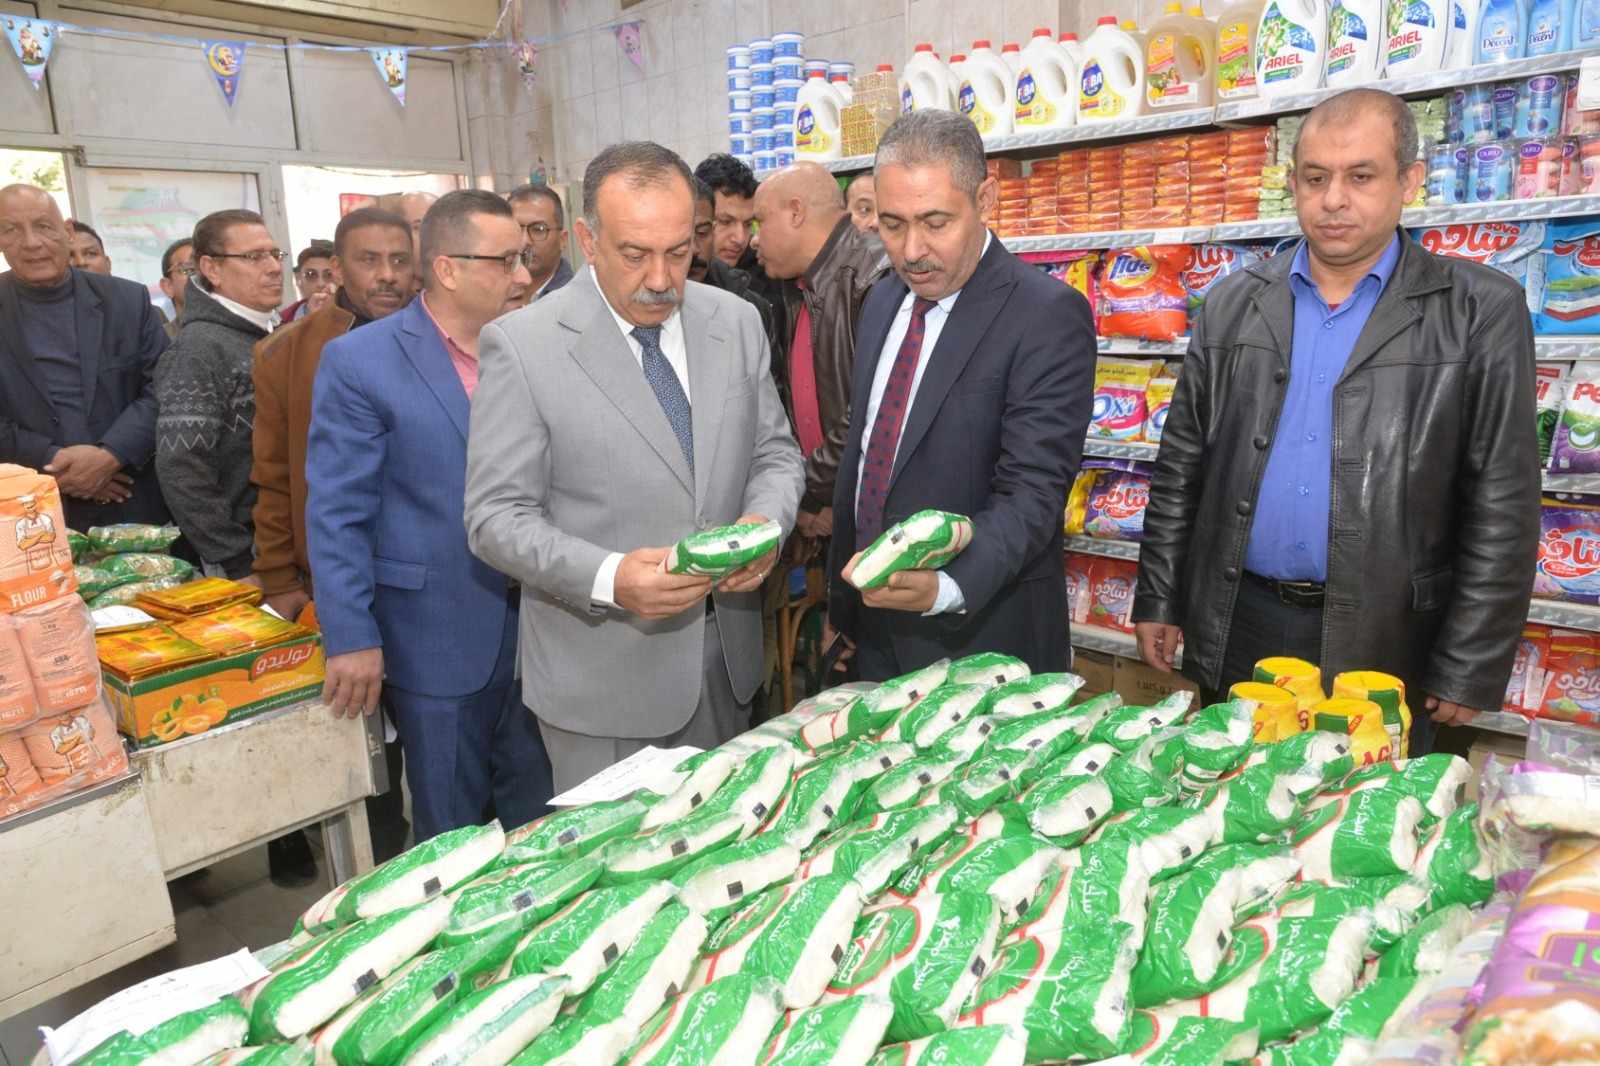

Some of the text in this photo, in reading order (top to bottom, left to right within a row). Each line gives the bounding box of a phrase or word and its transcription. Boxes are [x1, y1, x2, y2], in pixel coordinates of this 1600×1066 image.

[1388, 30, 1422, 50] ARIEL
[1329, 42, 1356, 60] ARIEL
[1264, 52, 1304, 71] ARIEL
[1110, 255, 1150, 280] Tide
[11, 586, 47, 607] FLOUR
